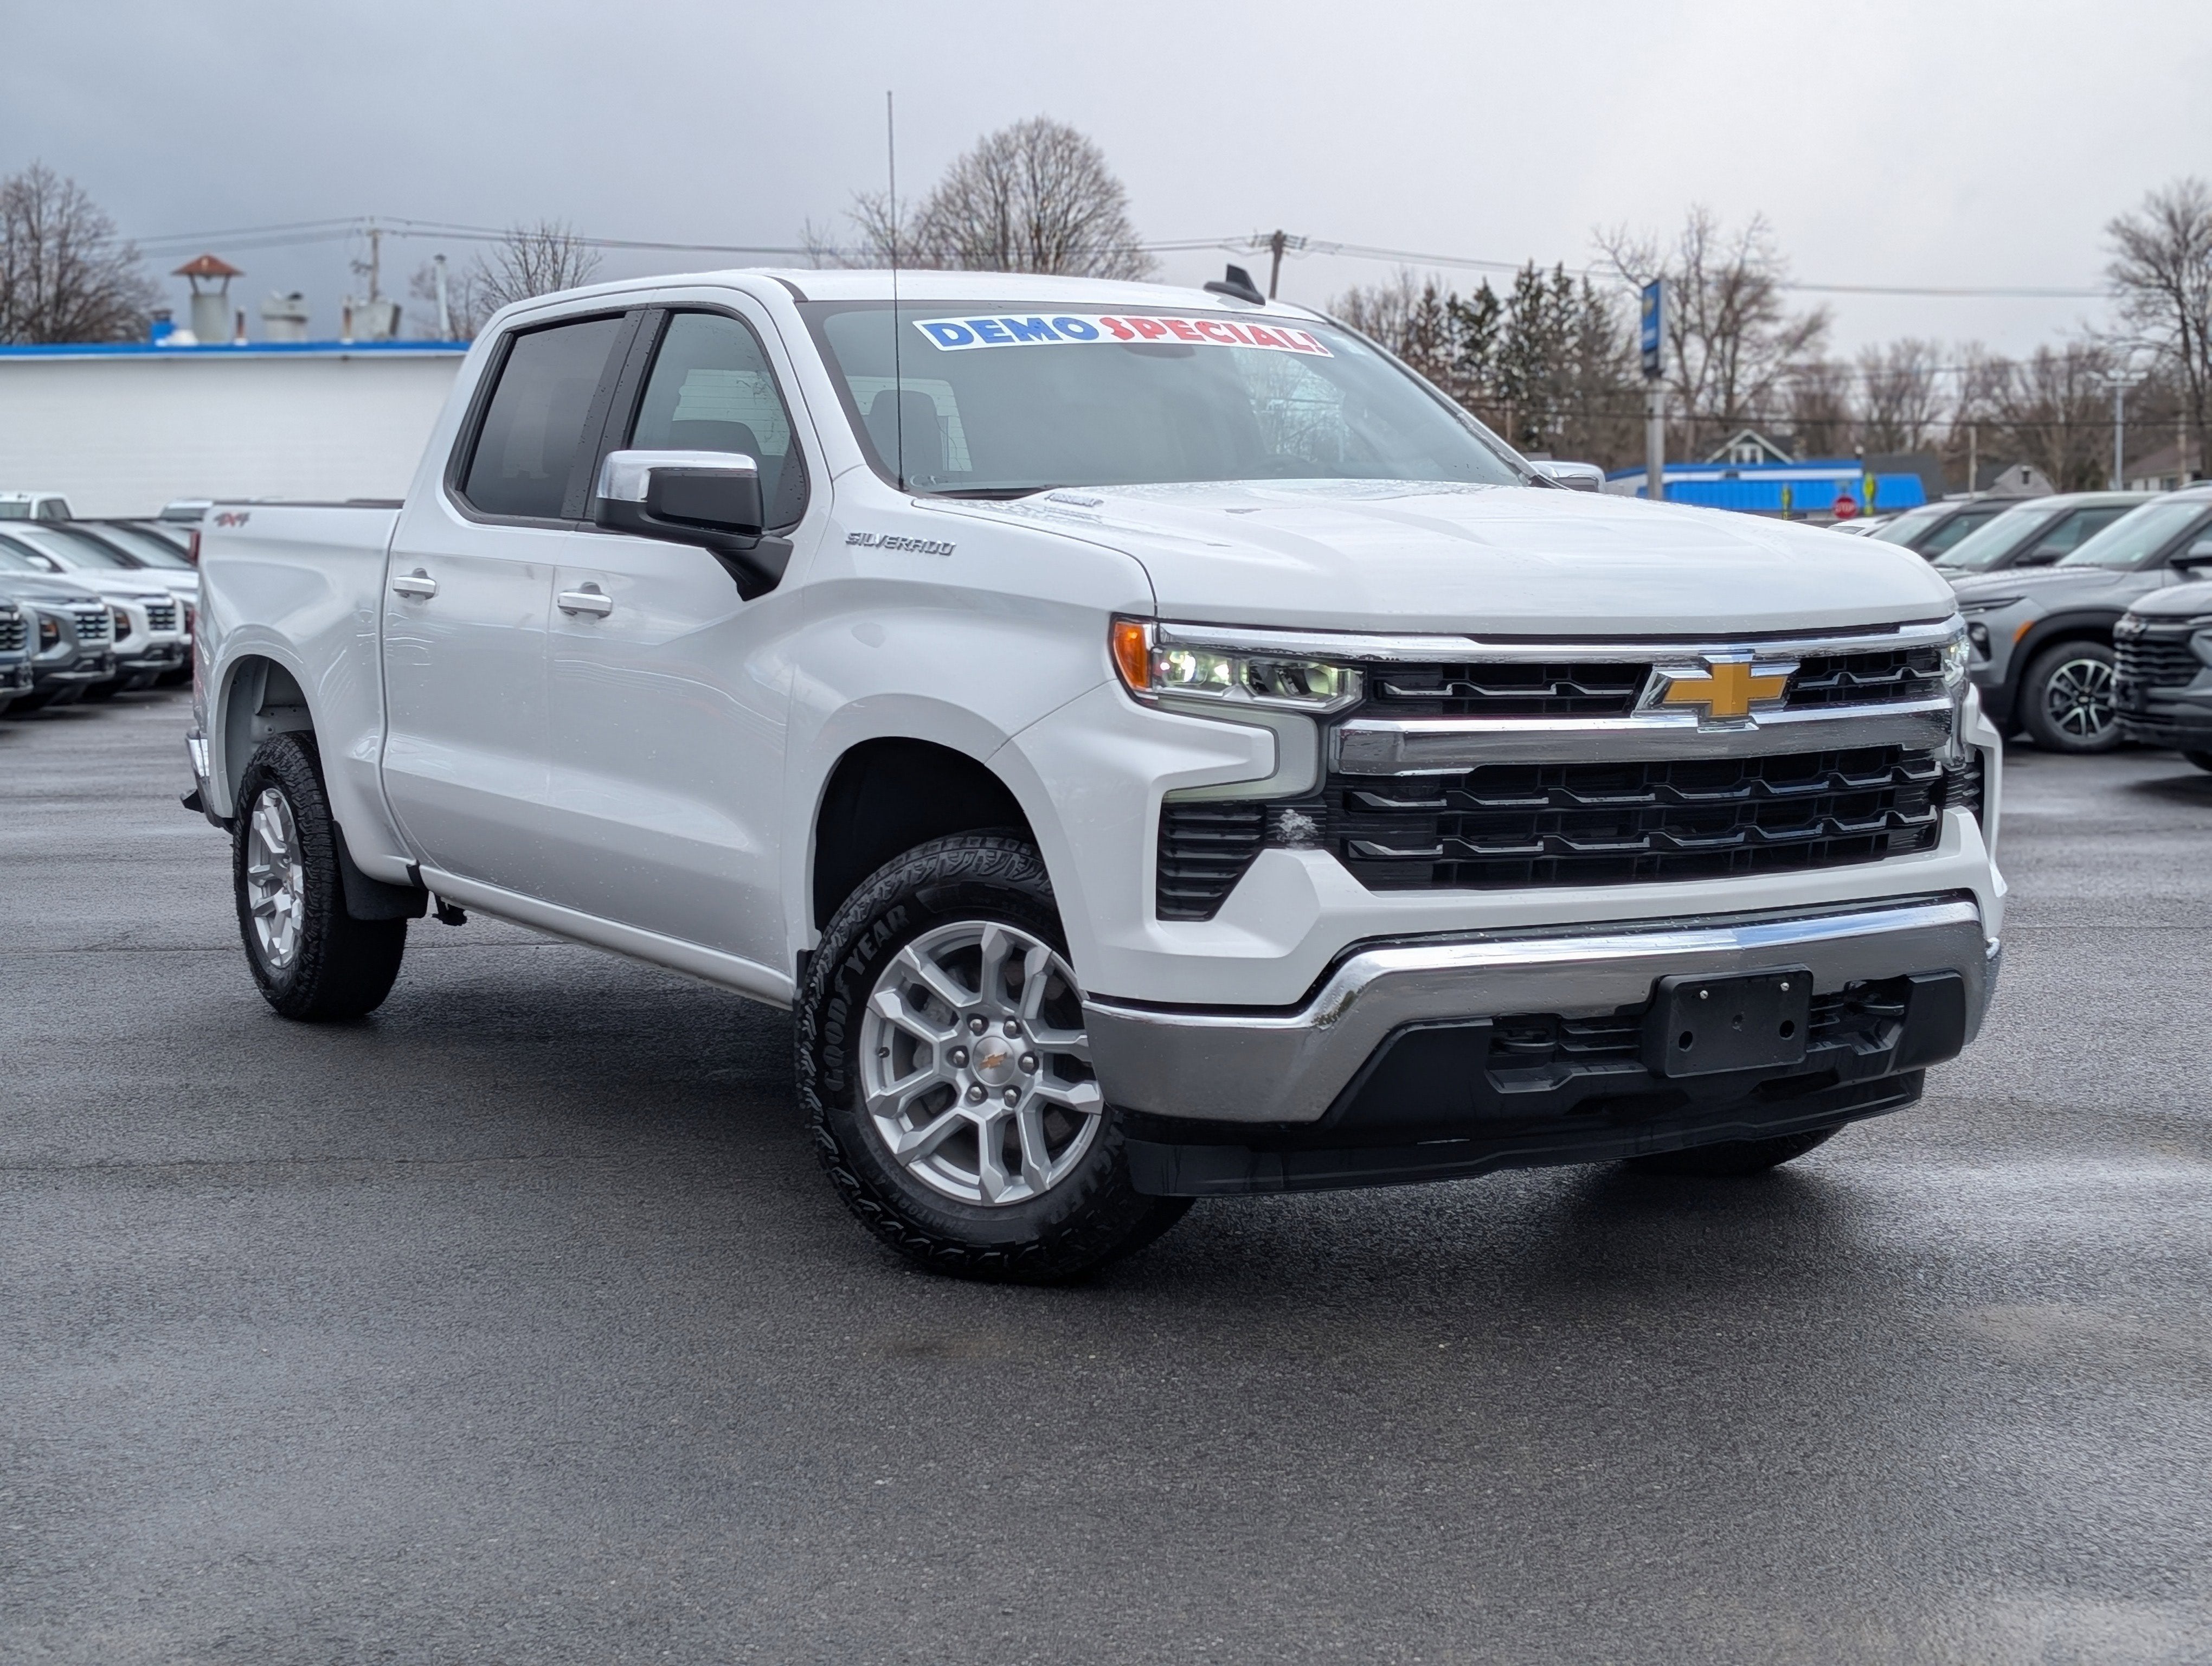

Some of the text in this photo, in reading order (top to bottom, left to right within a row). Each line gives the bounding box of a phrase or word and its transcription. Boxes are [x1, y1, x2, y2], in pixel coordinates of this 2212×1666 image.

[921, 317, 1329, 355] DEMO SPECIAL!
[845, 532, 957, 556] SILVERADO
